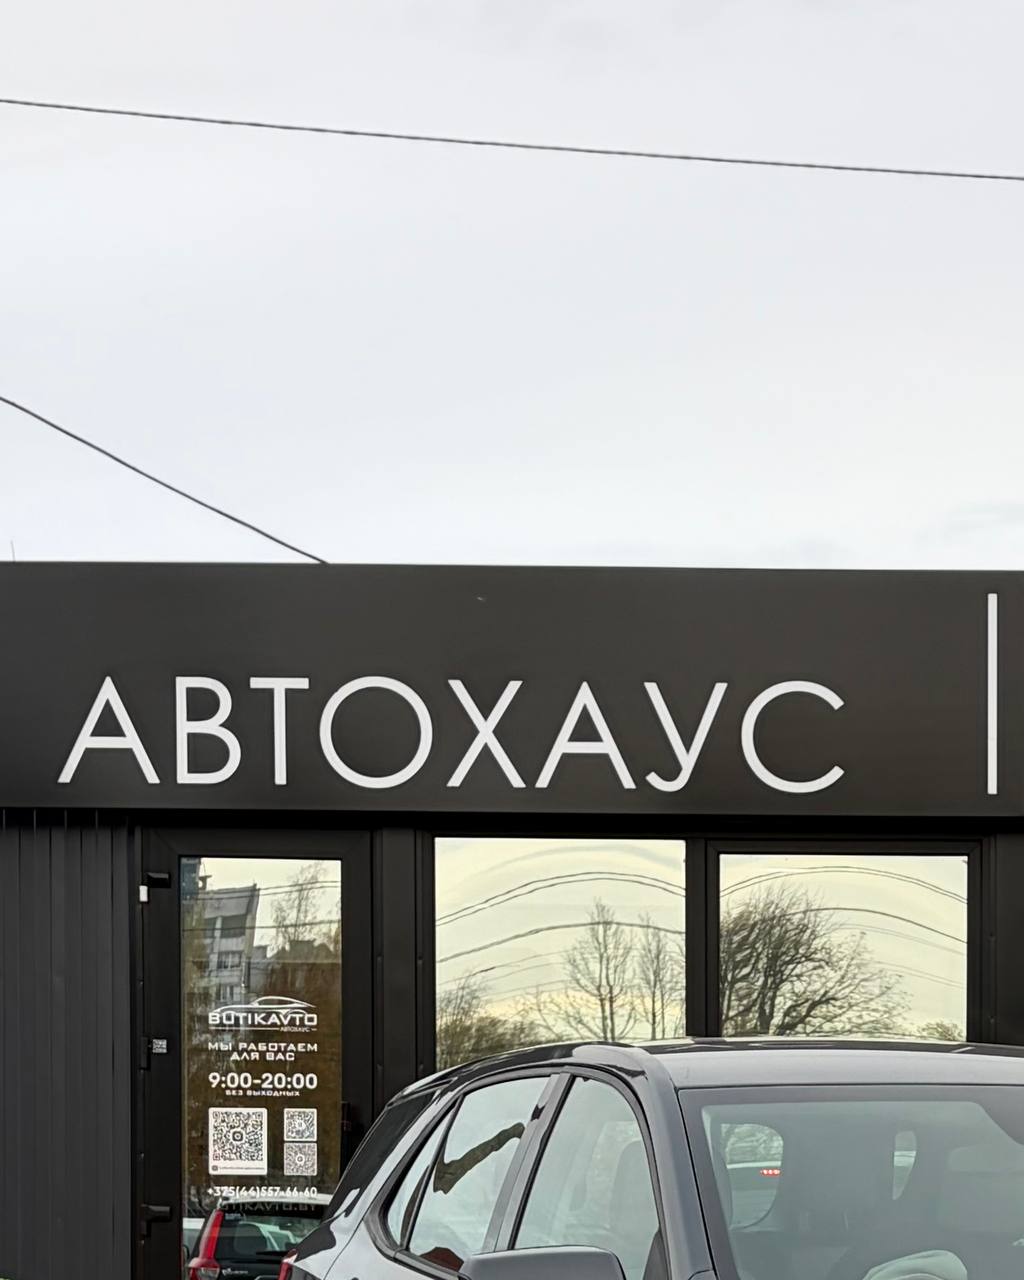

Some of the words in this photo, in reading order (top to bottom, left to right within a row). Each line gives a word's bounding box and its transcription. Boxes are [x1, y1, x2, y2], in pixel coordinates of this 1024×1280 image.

[57, 674, 847, 796] АВТОХАУС
[208, 1012, 318, 1026] BUTIKAVTO
[208, 1042, 232, 1051] МЫ
[238, 1042, 318, 1052] РАБОТАЕМ
[230, 1052, 260, 1061] ДЛЯ
[265, 1052, 296, 1061] ВАС
[208, 1072, 318, 1089] 9:00-20:00
[246, 1089, 301, 1097] ВЫХОДНЫХ
[207, 1186, 318, 1198] +375(44)557-66-60
